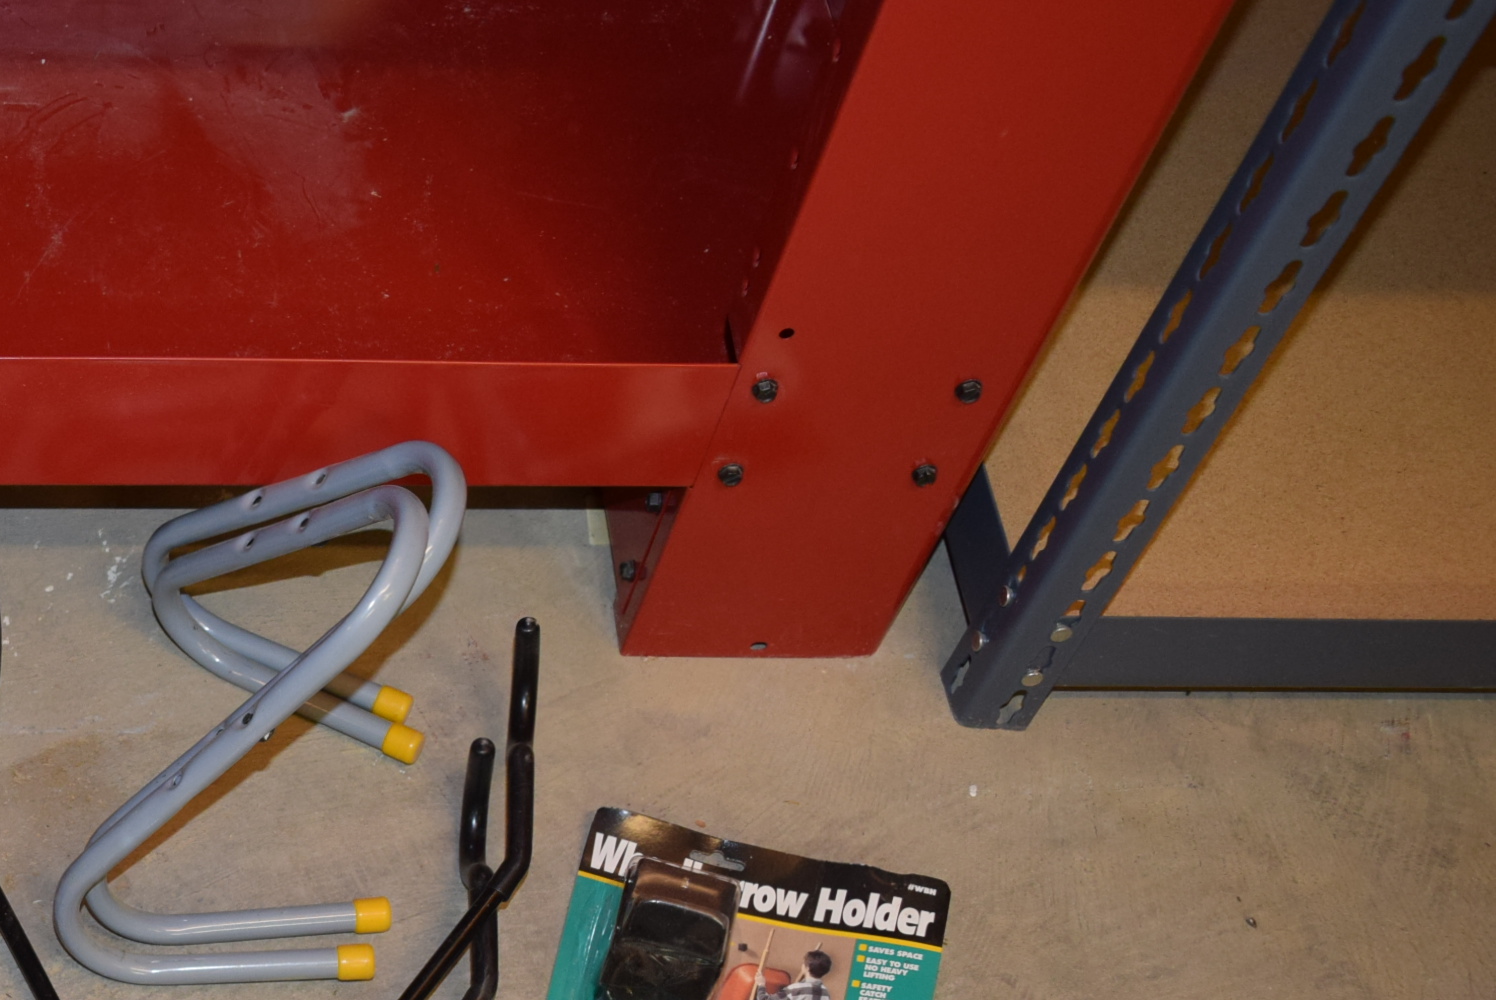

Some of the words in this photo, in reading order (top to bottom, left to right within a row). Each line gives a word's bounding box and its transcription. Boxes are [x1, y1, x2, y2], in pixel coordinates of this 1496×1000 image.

[813, 887, 936, 937] Holder
[868, 946, 895, 955] SAVES
[897, 950, 923, 960] SPACE
[864, 964, 878, 972] NO
[880, 966, 908, 976] HEAVY
[865, 957, 888, 966] EASY
[890, 960, 901, 968] TO
[903, 963, 920, 971] USE
[863, 971, 896, 981] LIFTING
[860, 982, 893, 992] SAFETY
[859, 989, 886, 998] CATCH
